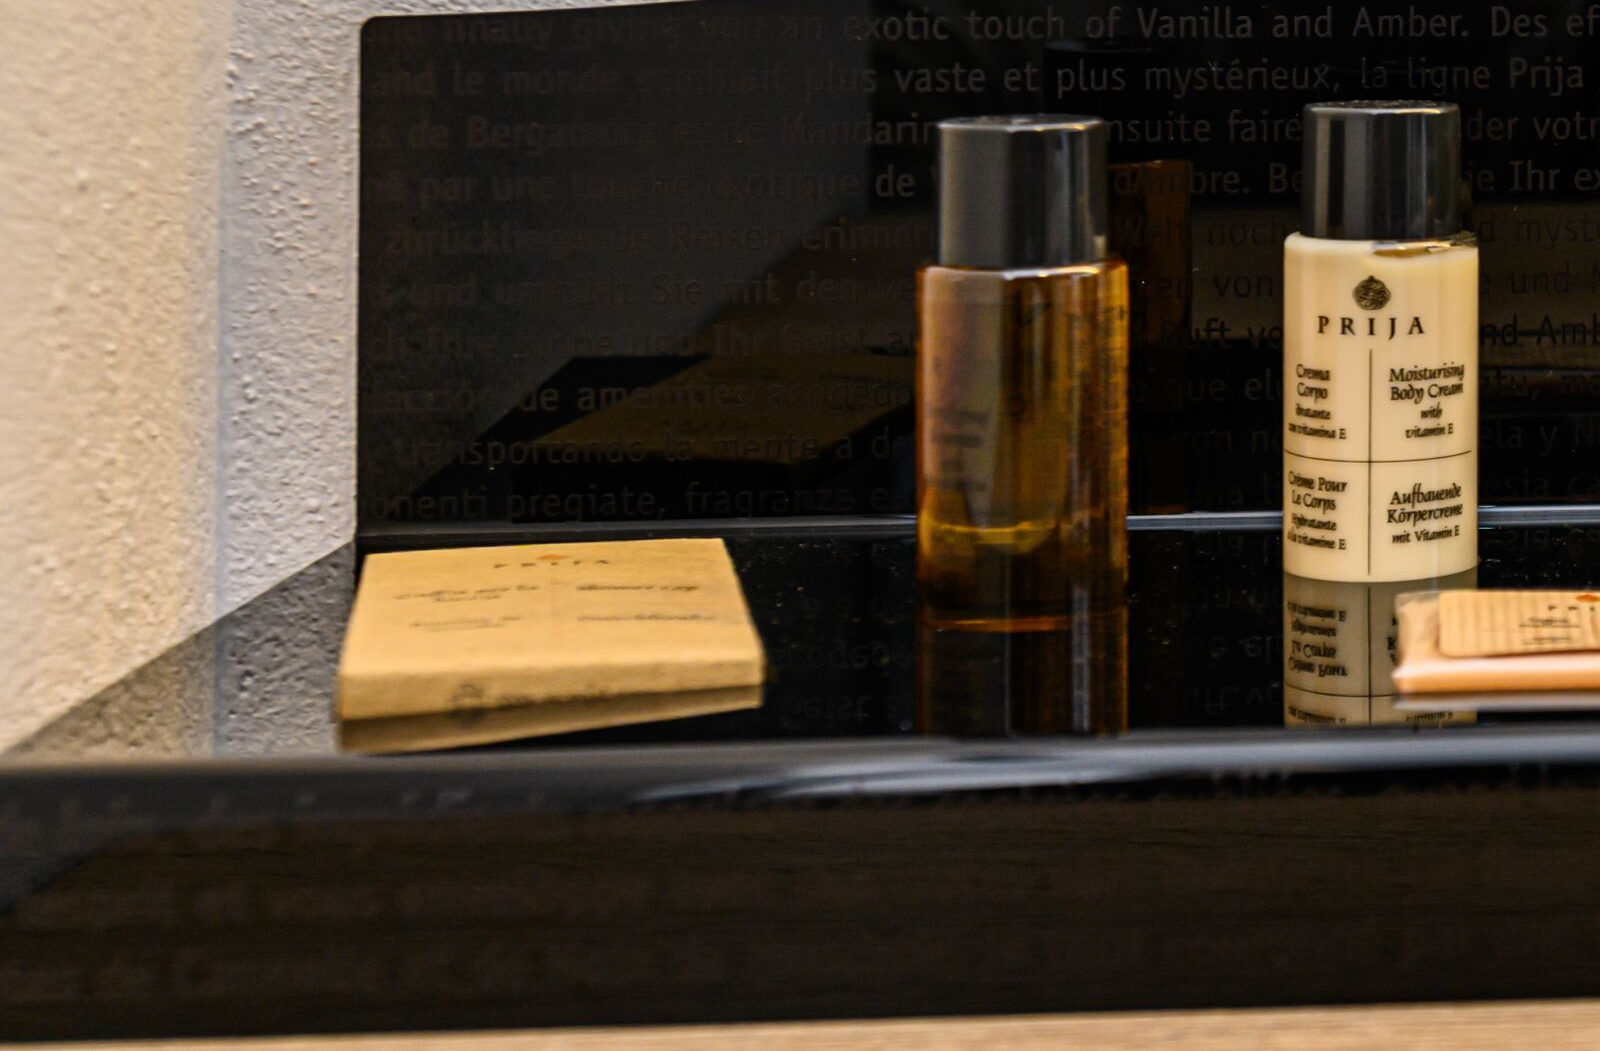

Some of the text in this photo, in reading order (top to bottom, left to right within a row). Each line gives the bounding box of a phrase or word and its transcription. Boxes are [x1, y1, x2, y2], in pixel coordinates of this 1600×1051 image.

[844, 6, 950, 41] exotic
[967, 6, 1065, 39] touch
[1085, 5, 1121, 39] of
[1136, 5, 1254, 39] Vanilla
[1271, 5, 1332, 37] and
[1351, 5, 1470, 38] Amber.
[1490, 5, 1548, 37] Des
[894, 63, 986, 92] vaste
[1003, 64, 1040, 92] et
[1056, 59, 1127, 100] plus
[1144, 58, 1342, 100] mystérieux,
[1359, 55, 1389, 90] la
[1407, 55, 1491, 96] ligne
[1508, 55, 1585, 97] Prija
[1105, 109, 1211, 143] nsuite
[1227, 109, 1303, 143] faire
[874, 163, 916, 198] de
[1508, 159, 1562, 192] Ihr
[1212, 275, 1274, 299] von
[1509, 262, 1571, 295] und
[1316, 314, 1425, 340] PRIJA
[1389, 383, 1424, 404] Body
[1427, 382, 1464, 399] Cream
[1318, 476, 1348, 493] Pour
[1389, 481, 1463, 508] Aufbauende
[1302, 492, 1337, 515] Corps
